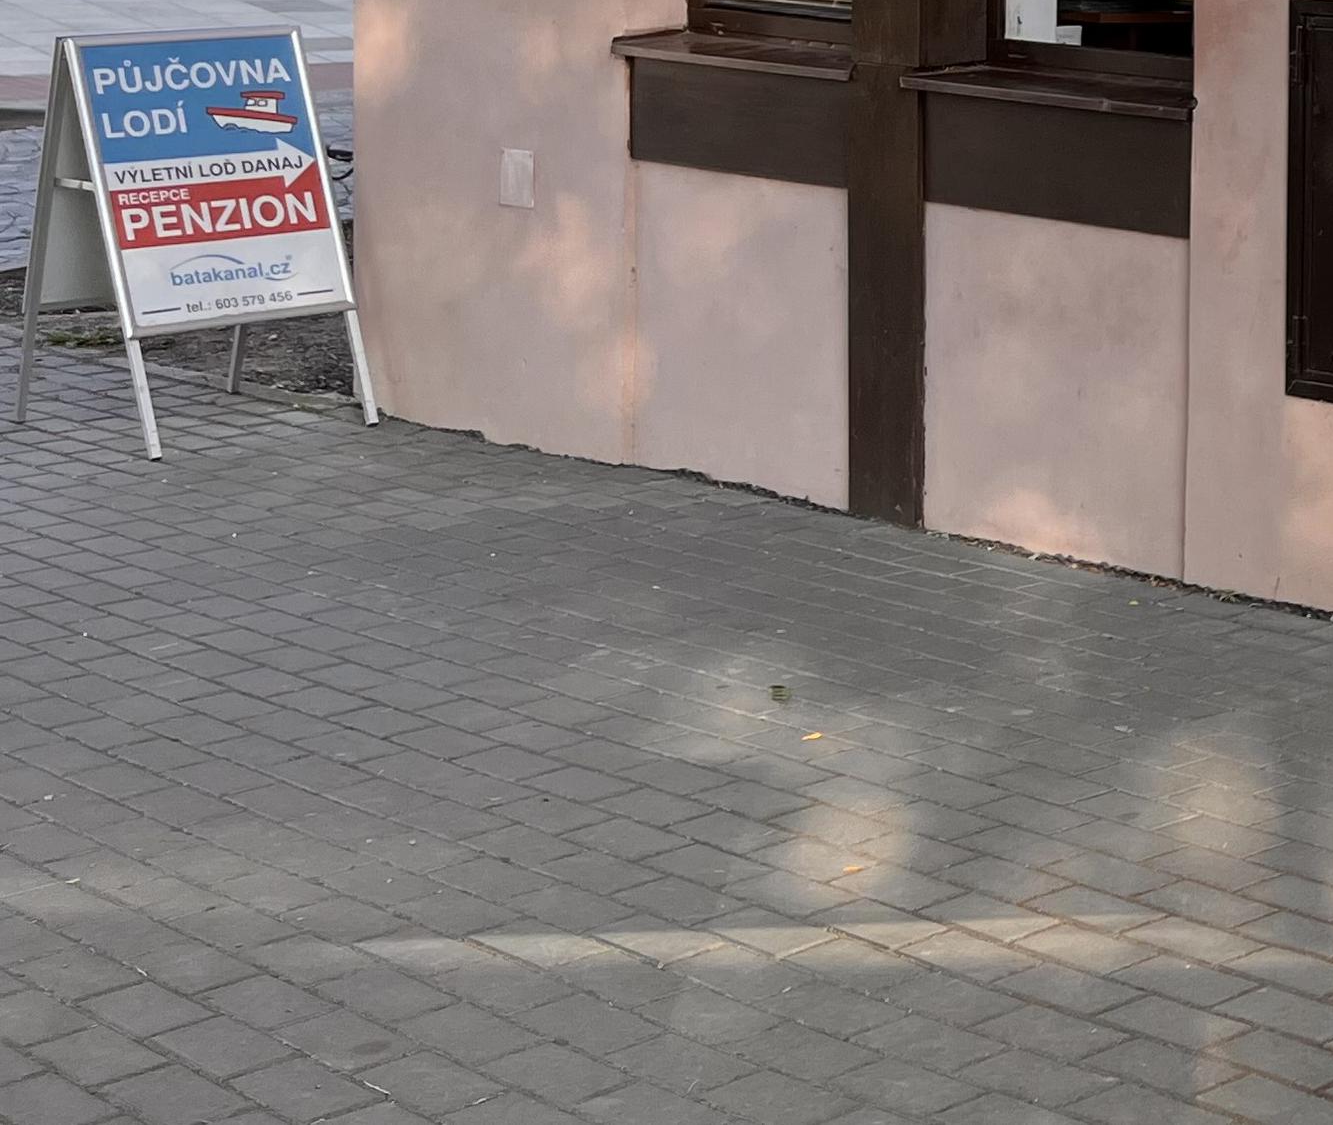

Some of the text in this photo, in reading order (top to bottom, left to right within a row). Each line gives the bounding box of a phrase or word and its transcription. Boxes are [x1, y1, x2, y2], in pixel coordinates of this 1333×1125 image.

[92, 56, 292, 95] PŮJČOVNA
[101, 100, 188, 139] LODÍ
[114, 155, 304, 185] VÝLETNÍ LOĎ DANAJ
[117, 188, 191, 206] RECEPCE
[120, 191, 318, 242] PENZION
[170, 261, 292, 287] batakanal.cz
[186, 291, 294, 314] tel.: 603 579 456
